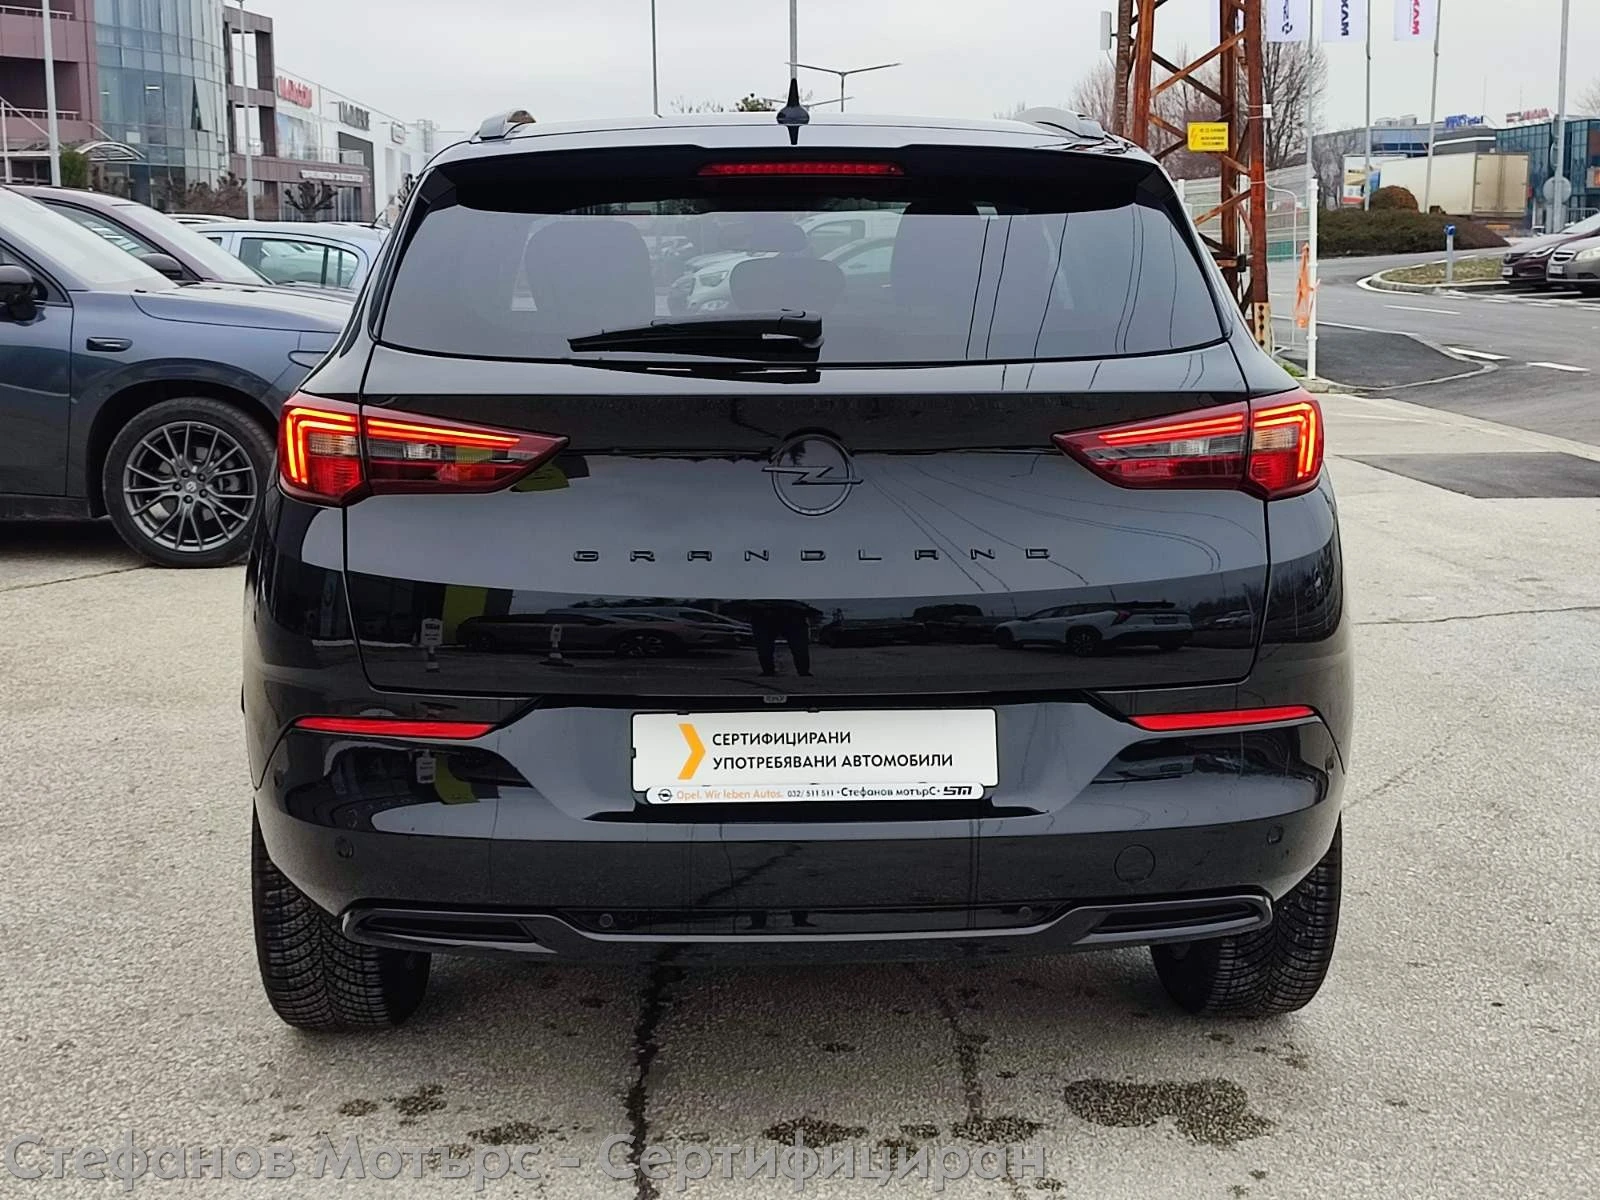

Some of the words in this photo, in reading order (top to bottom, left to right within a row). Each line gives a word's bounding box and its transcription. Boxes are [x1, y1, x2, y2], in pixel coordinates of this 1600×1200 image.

[573, 547, 1050, 562] GRANDLAND
[712, 731, 851, 747] СЕРТИФИЦИРАНИ
[712, 755, 838, 770] УПОТРЕБЯВАНИ
[841, 753, 953, 768] АВТОМОБИЛИ
[705, 790, 721, 799] Wir
[723, 789, 750, 799] leben
[841, 786, 893, 799] Стефанов
